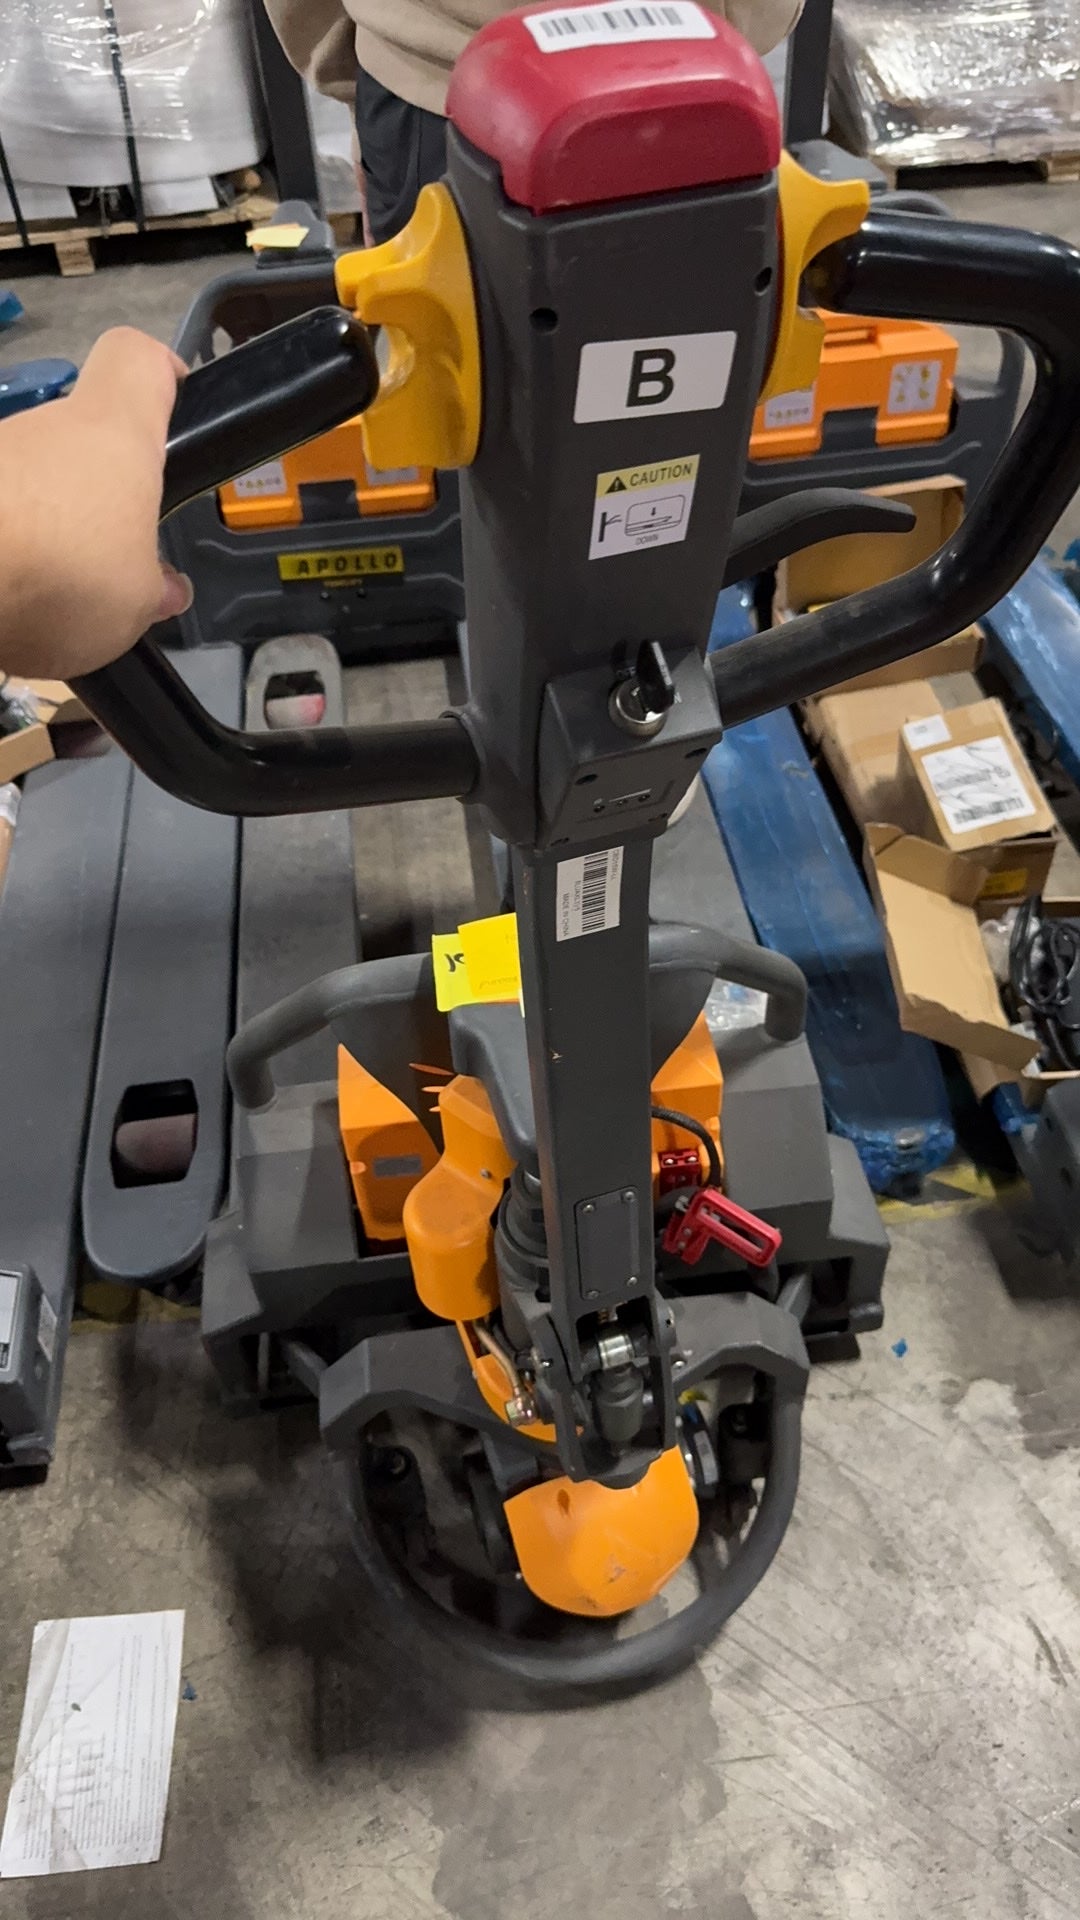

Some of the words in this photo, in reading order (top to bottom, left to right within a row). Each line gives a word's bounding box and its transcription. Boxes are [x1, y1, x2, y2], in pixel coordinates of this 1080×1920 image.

[625, 348, 676, 408] B
[629, 463, 693, 487] CAUTION
[635, 533, 659, 546] DOWN
[298, 552, 397, 576] APOLLO
